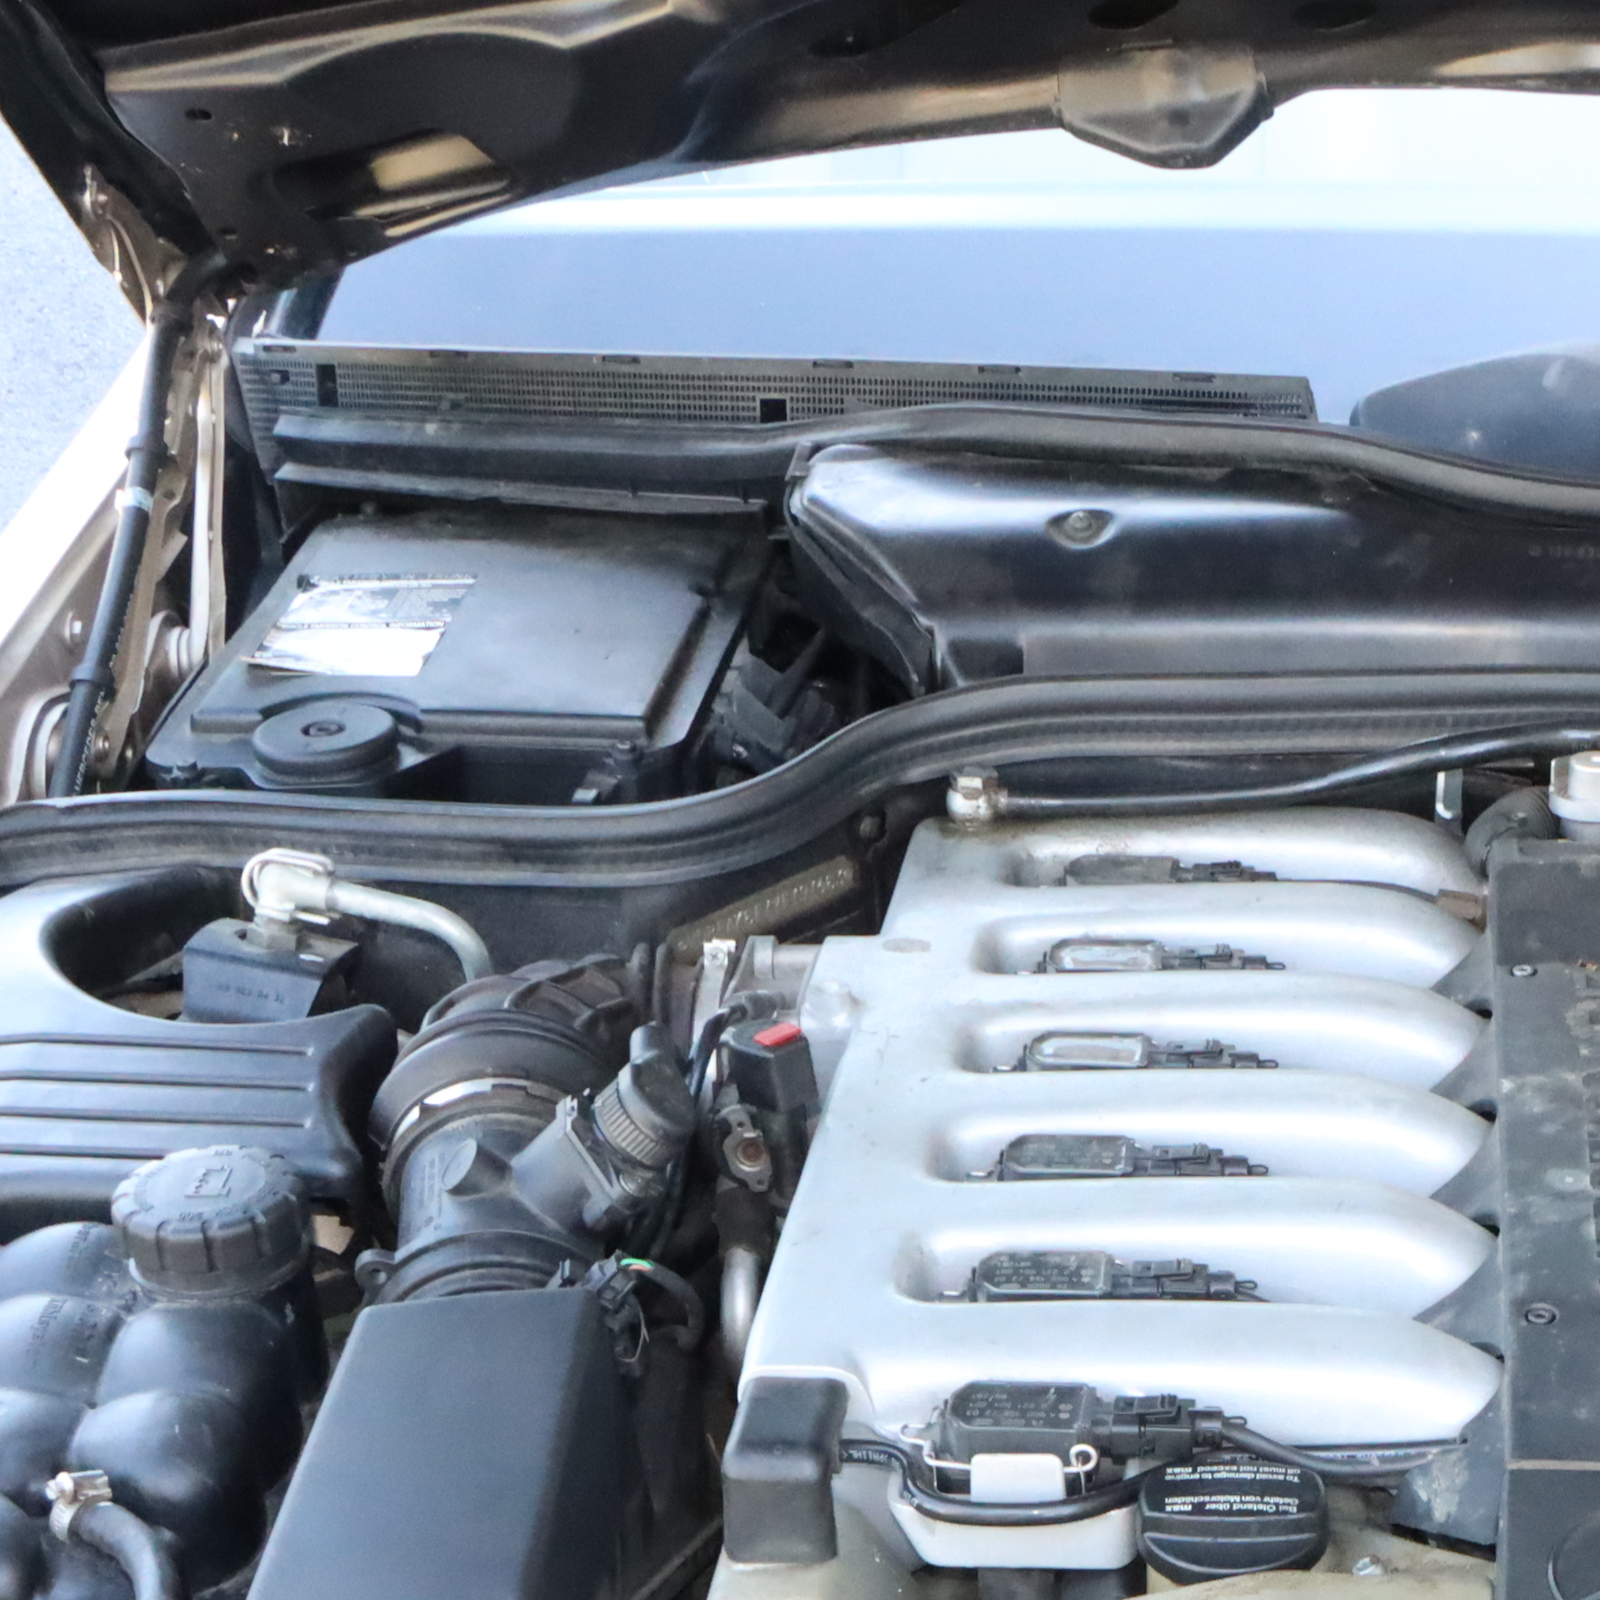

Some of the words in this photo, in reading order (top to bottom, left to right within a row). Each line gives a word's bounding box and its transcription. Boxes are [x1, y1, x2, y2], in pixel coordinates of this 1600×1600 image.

[1256, 1473, 1285, 1481] avoid
[1286, 1474, 1300, 1483] To
[1164, 1504, 1192, 1512] max
